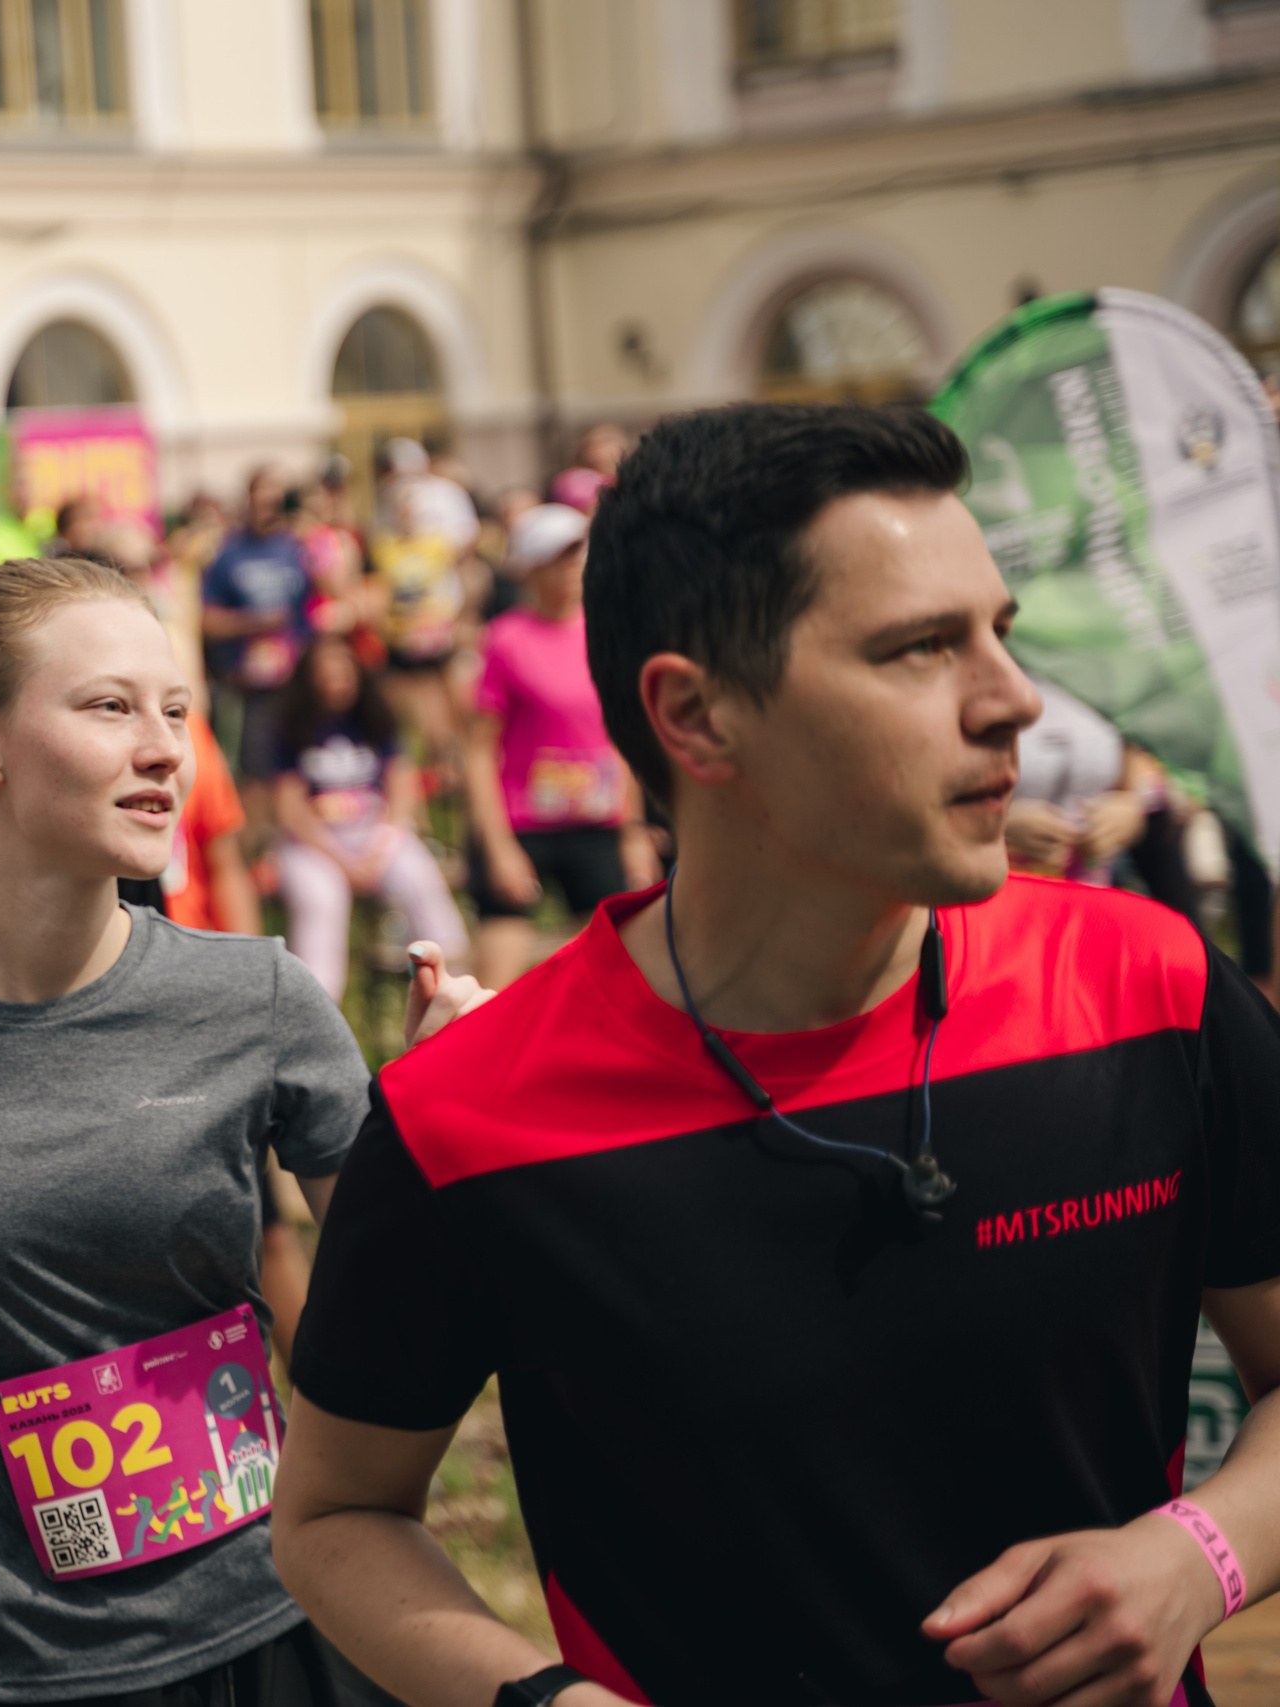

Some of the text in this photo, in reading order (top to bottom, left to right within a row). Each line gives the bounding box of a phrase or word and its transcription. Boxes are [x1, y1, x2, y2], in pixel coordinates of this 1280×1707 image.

[975, 1169, 1183, 1250] #MTSRUNNING
[2, 1382, 72, 1415] RUTS
[219, 1371, 238, 1394] 1
[9, 1403, 93, 1433] КАЗАНЬ 2023
[7, 1402, 174, 1499] 102
